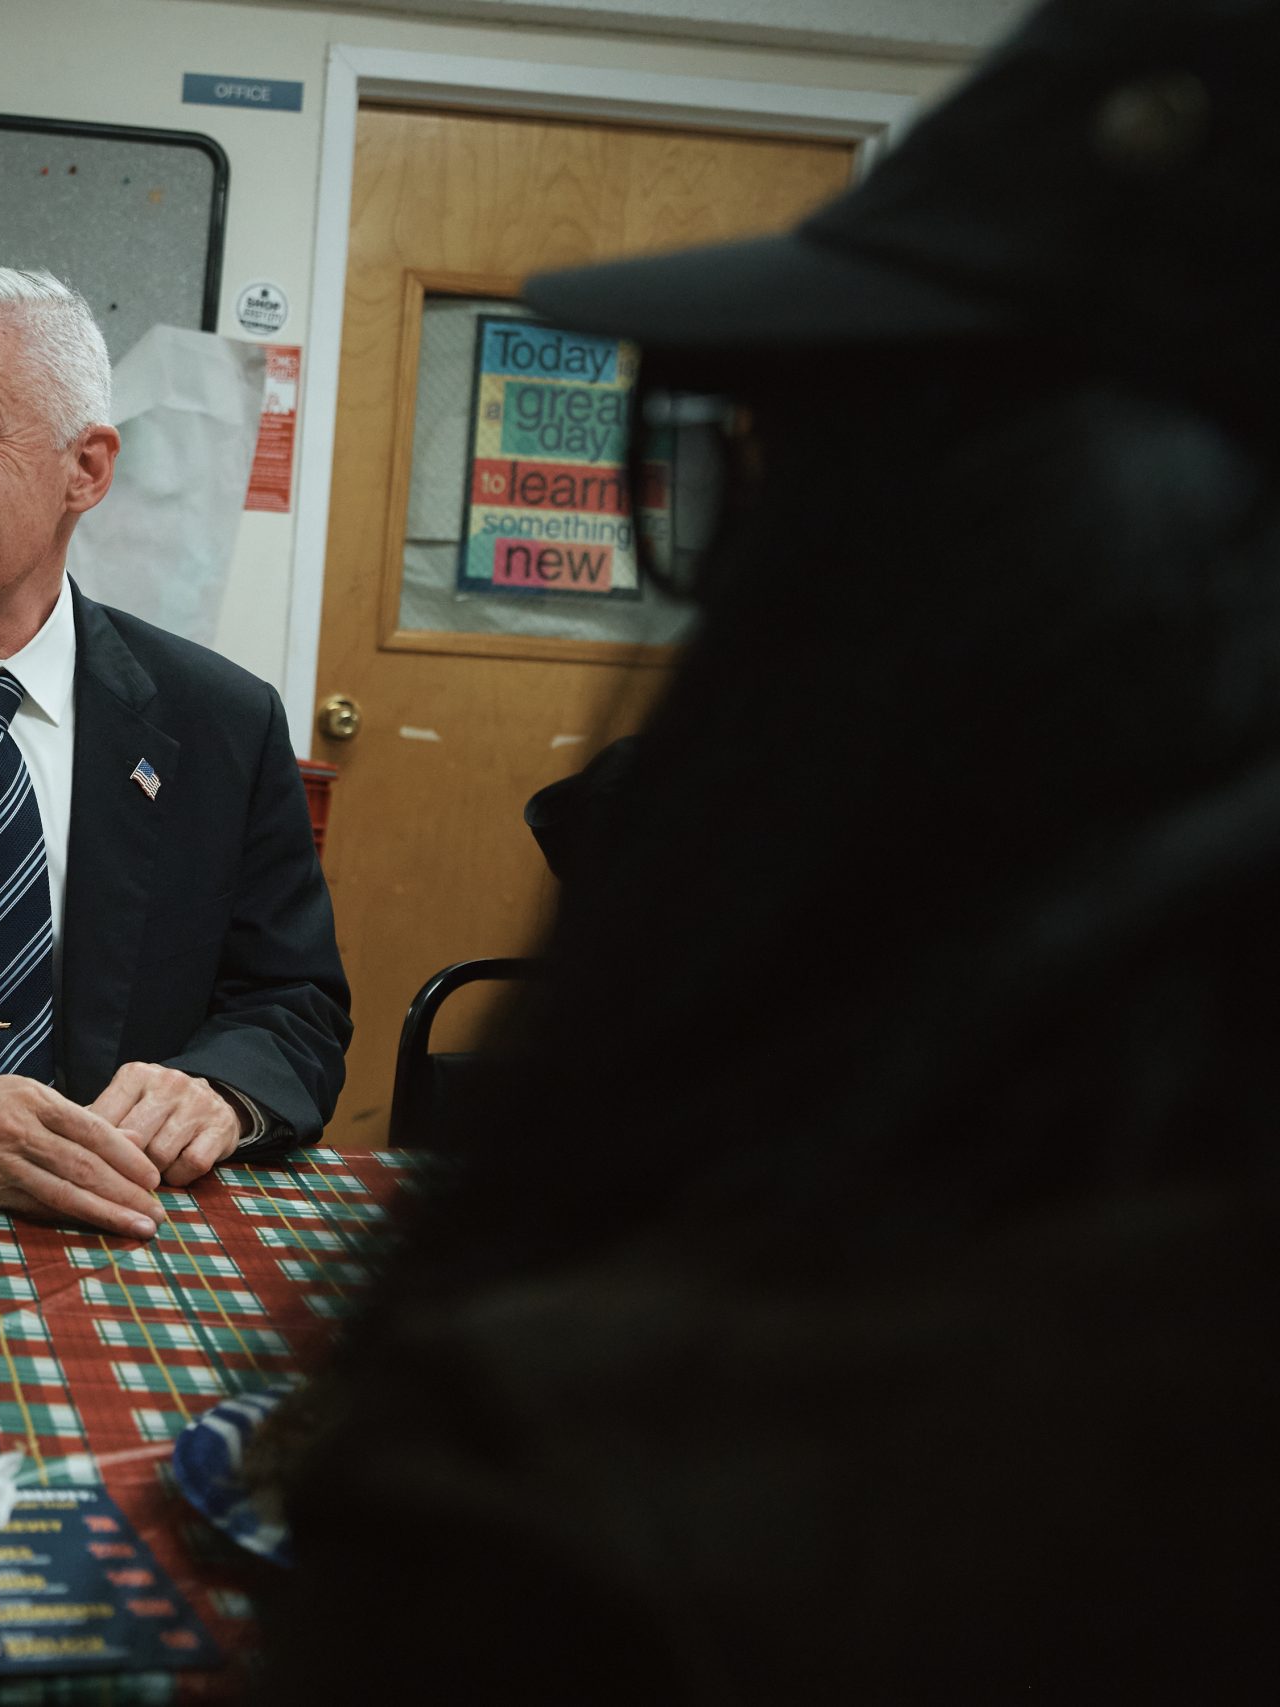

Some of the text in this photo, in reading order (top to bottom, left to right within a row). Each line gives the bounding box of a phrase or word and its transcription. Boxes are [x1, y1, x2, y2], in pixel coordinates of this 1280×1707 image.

[214, 82, 272, 101] OFFICE
[493, 331, 612, 384] Today
[486, 383, 625, 433] a grea
[538, 415, 613, 463] day
[480, 460, 624, 511] to learn
[482, 512, 632, 549] something
[504, 543, 607, 585] new
